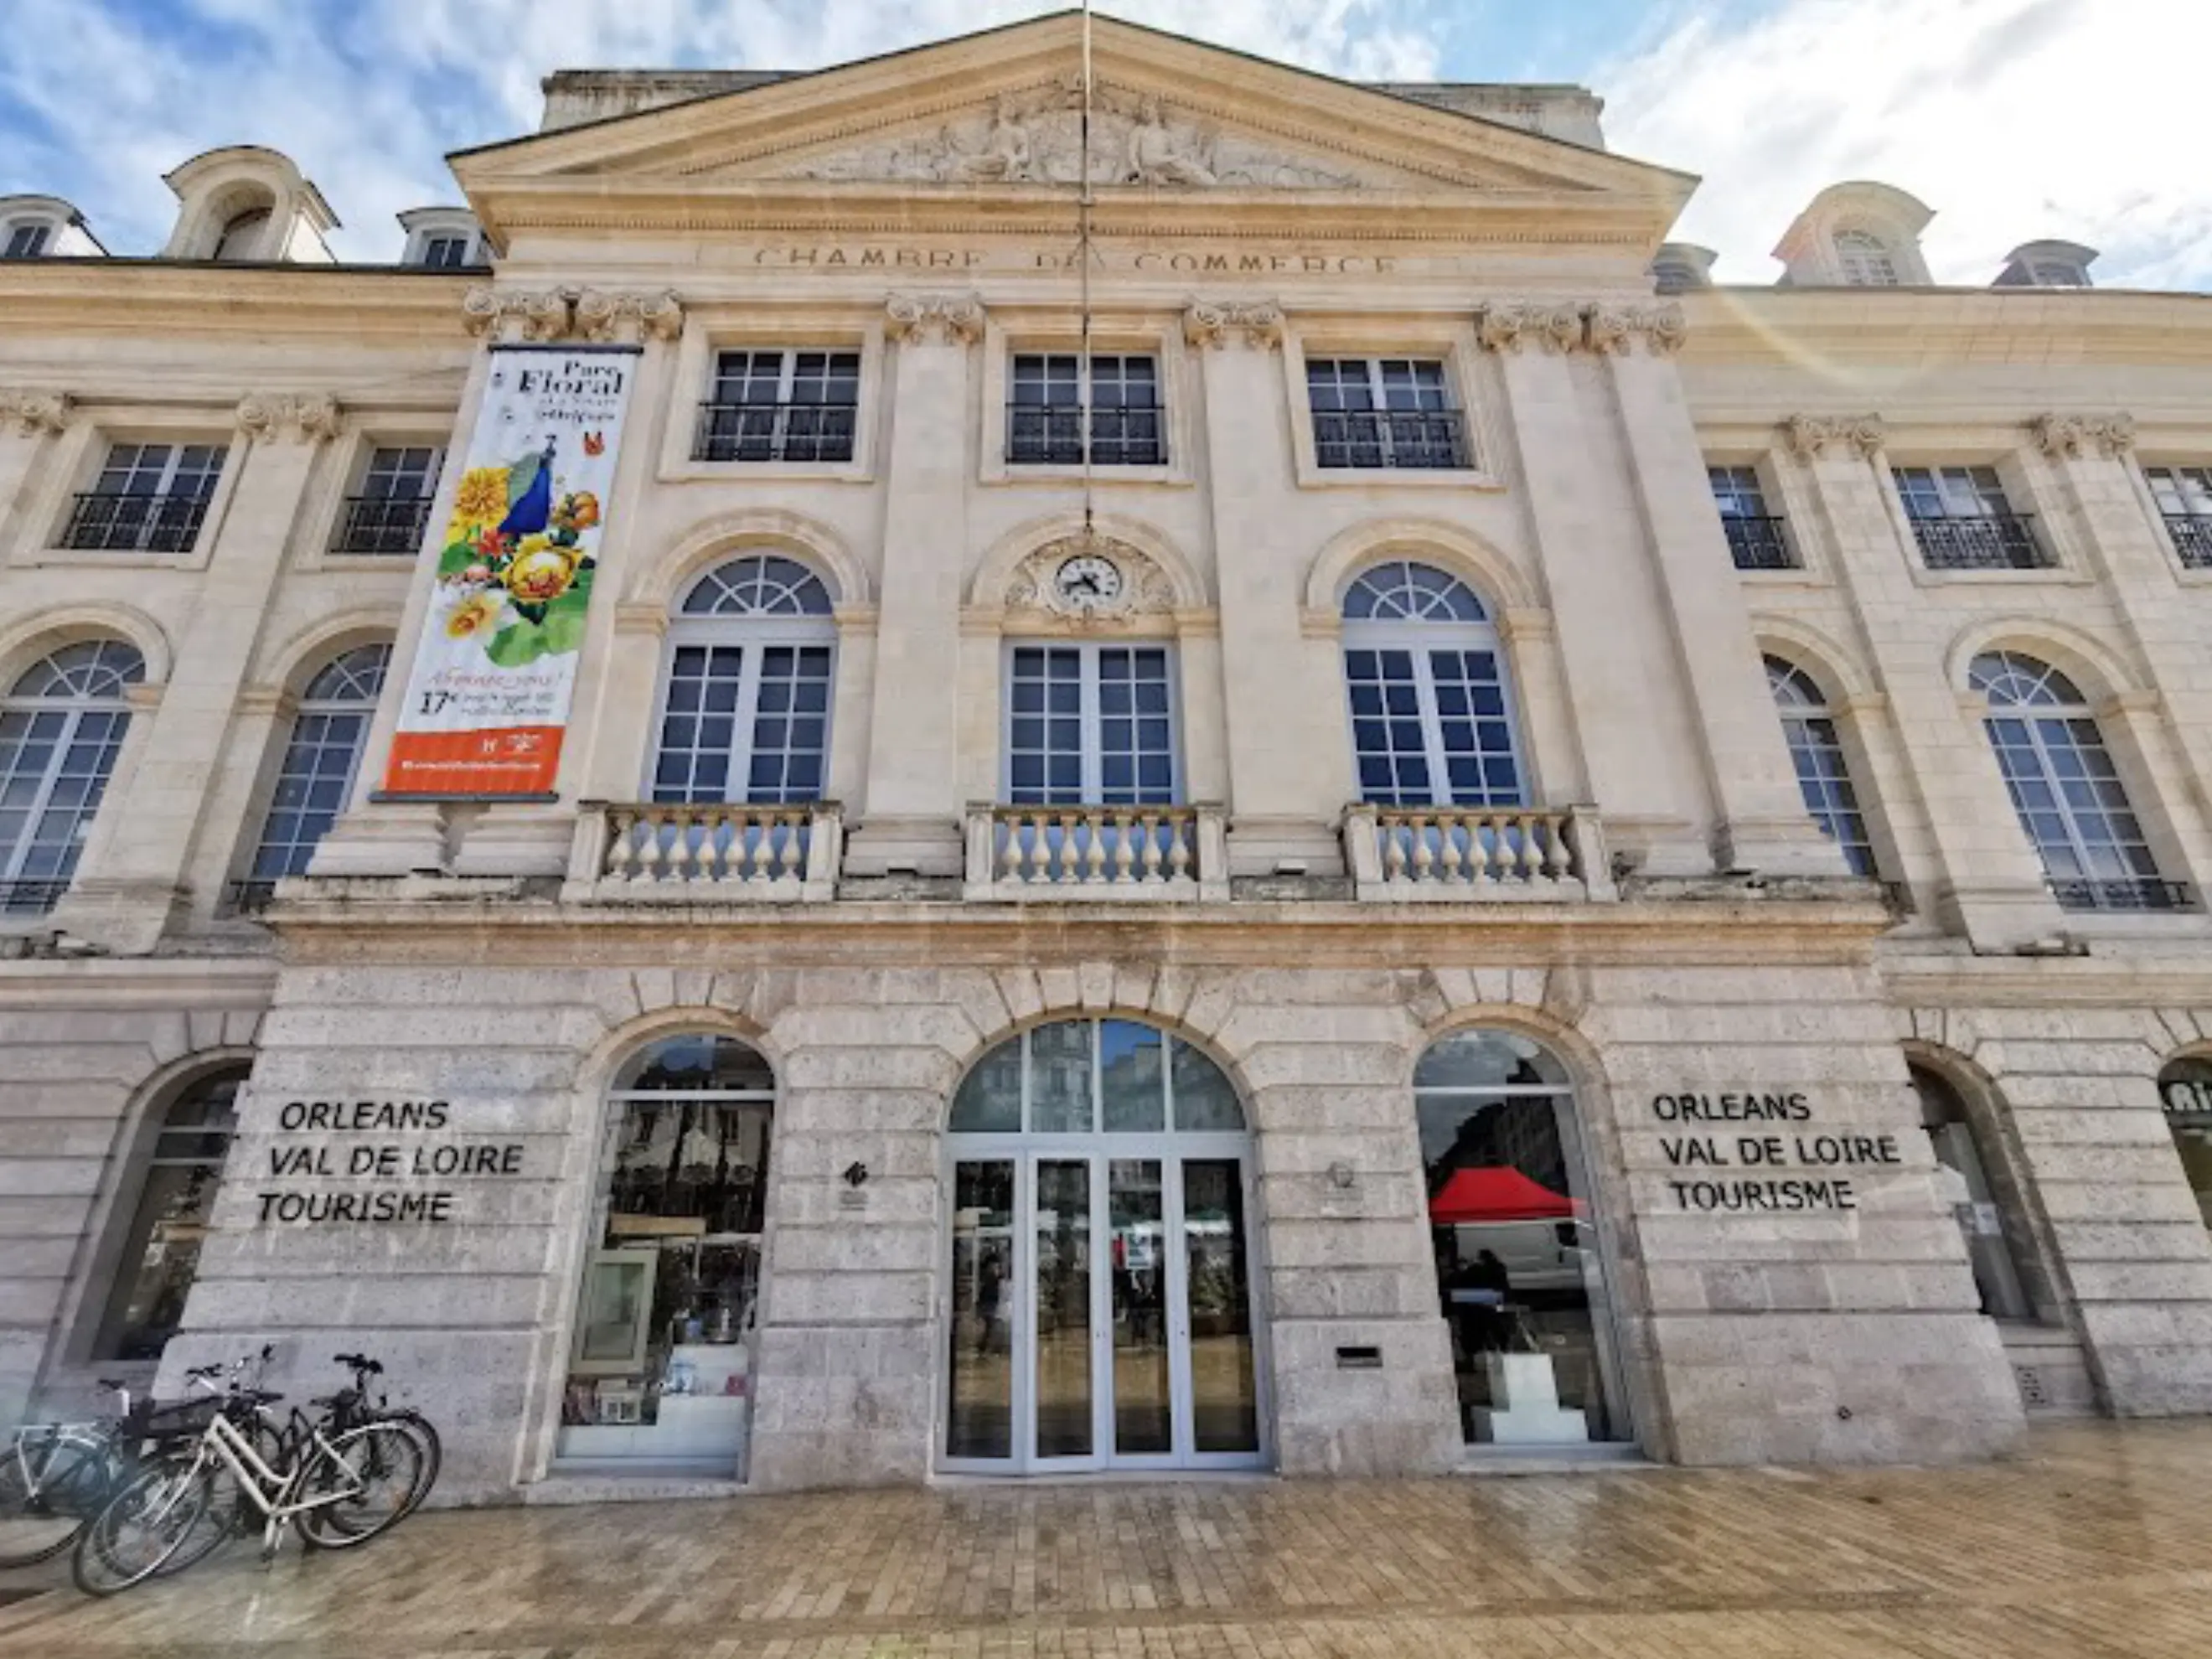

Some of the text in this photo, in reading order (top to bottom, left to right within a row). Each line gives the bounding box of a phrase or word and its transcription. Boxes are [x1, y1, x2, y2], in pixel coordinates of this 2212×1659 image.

[755, 248, 990, 268] CHAMBRE
[1134, 253, 1398, 274] COMMERCE
[519, 369, 623, 395] Floral
[564, 360, 618, 376] Parc
[279, 1101, 449, 1130] ORLEANS
[1651, 1093, 1811, 1124] ORLEANS
[270, 1145, 525, 1176] VAL DE LOIRE
[1658, 1135, 1901, 1167] VAL DE LOIRE
[256, 1191, 454, 1222] TOURISME
[1668, 1181, 1856, 1212] TOURISME
